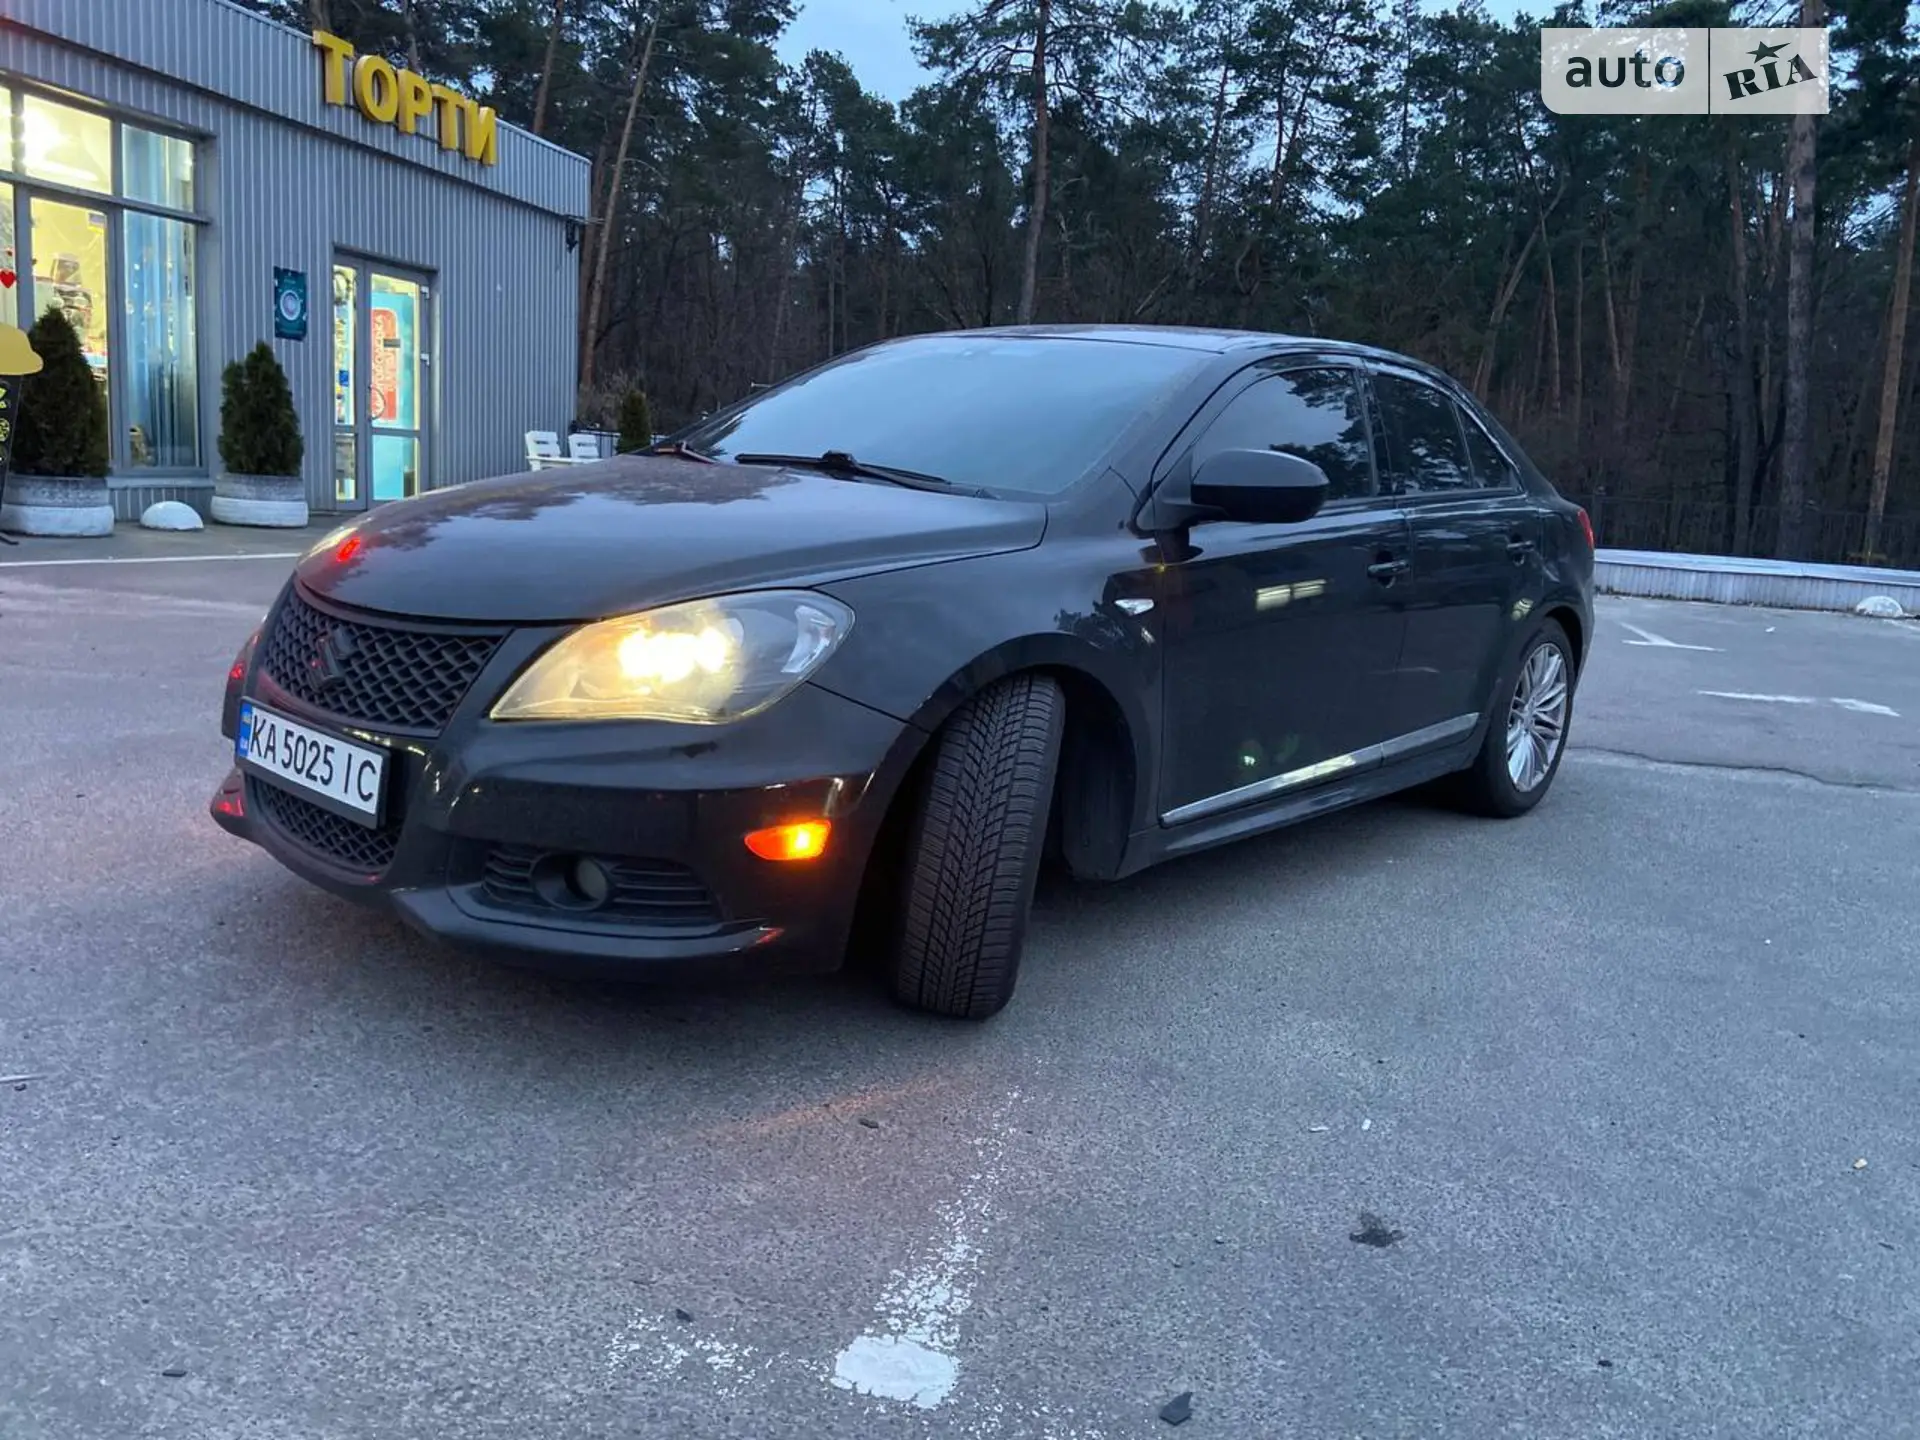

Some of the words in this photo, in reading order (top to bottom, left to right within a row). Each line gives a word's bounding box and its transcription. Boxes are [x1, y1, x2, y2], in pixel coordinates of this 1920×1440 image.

[312, 30, 496, 166] ТОРТИ
[250, 715, 277, 764] KA
[281, 730, 335, 786] 5025
[343, 753, 376, 802] IC
